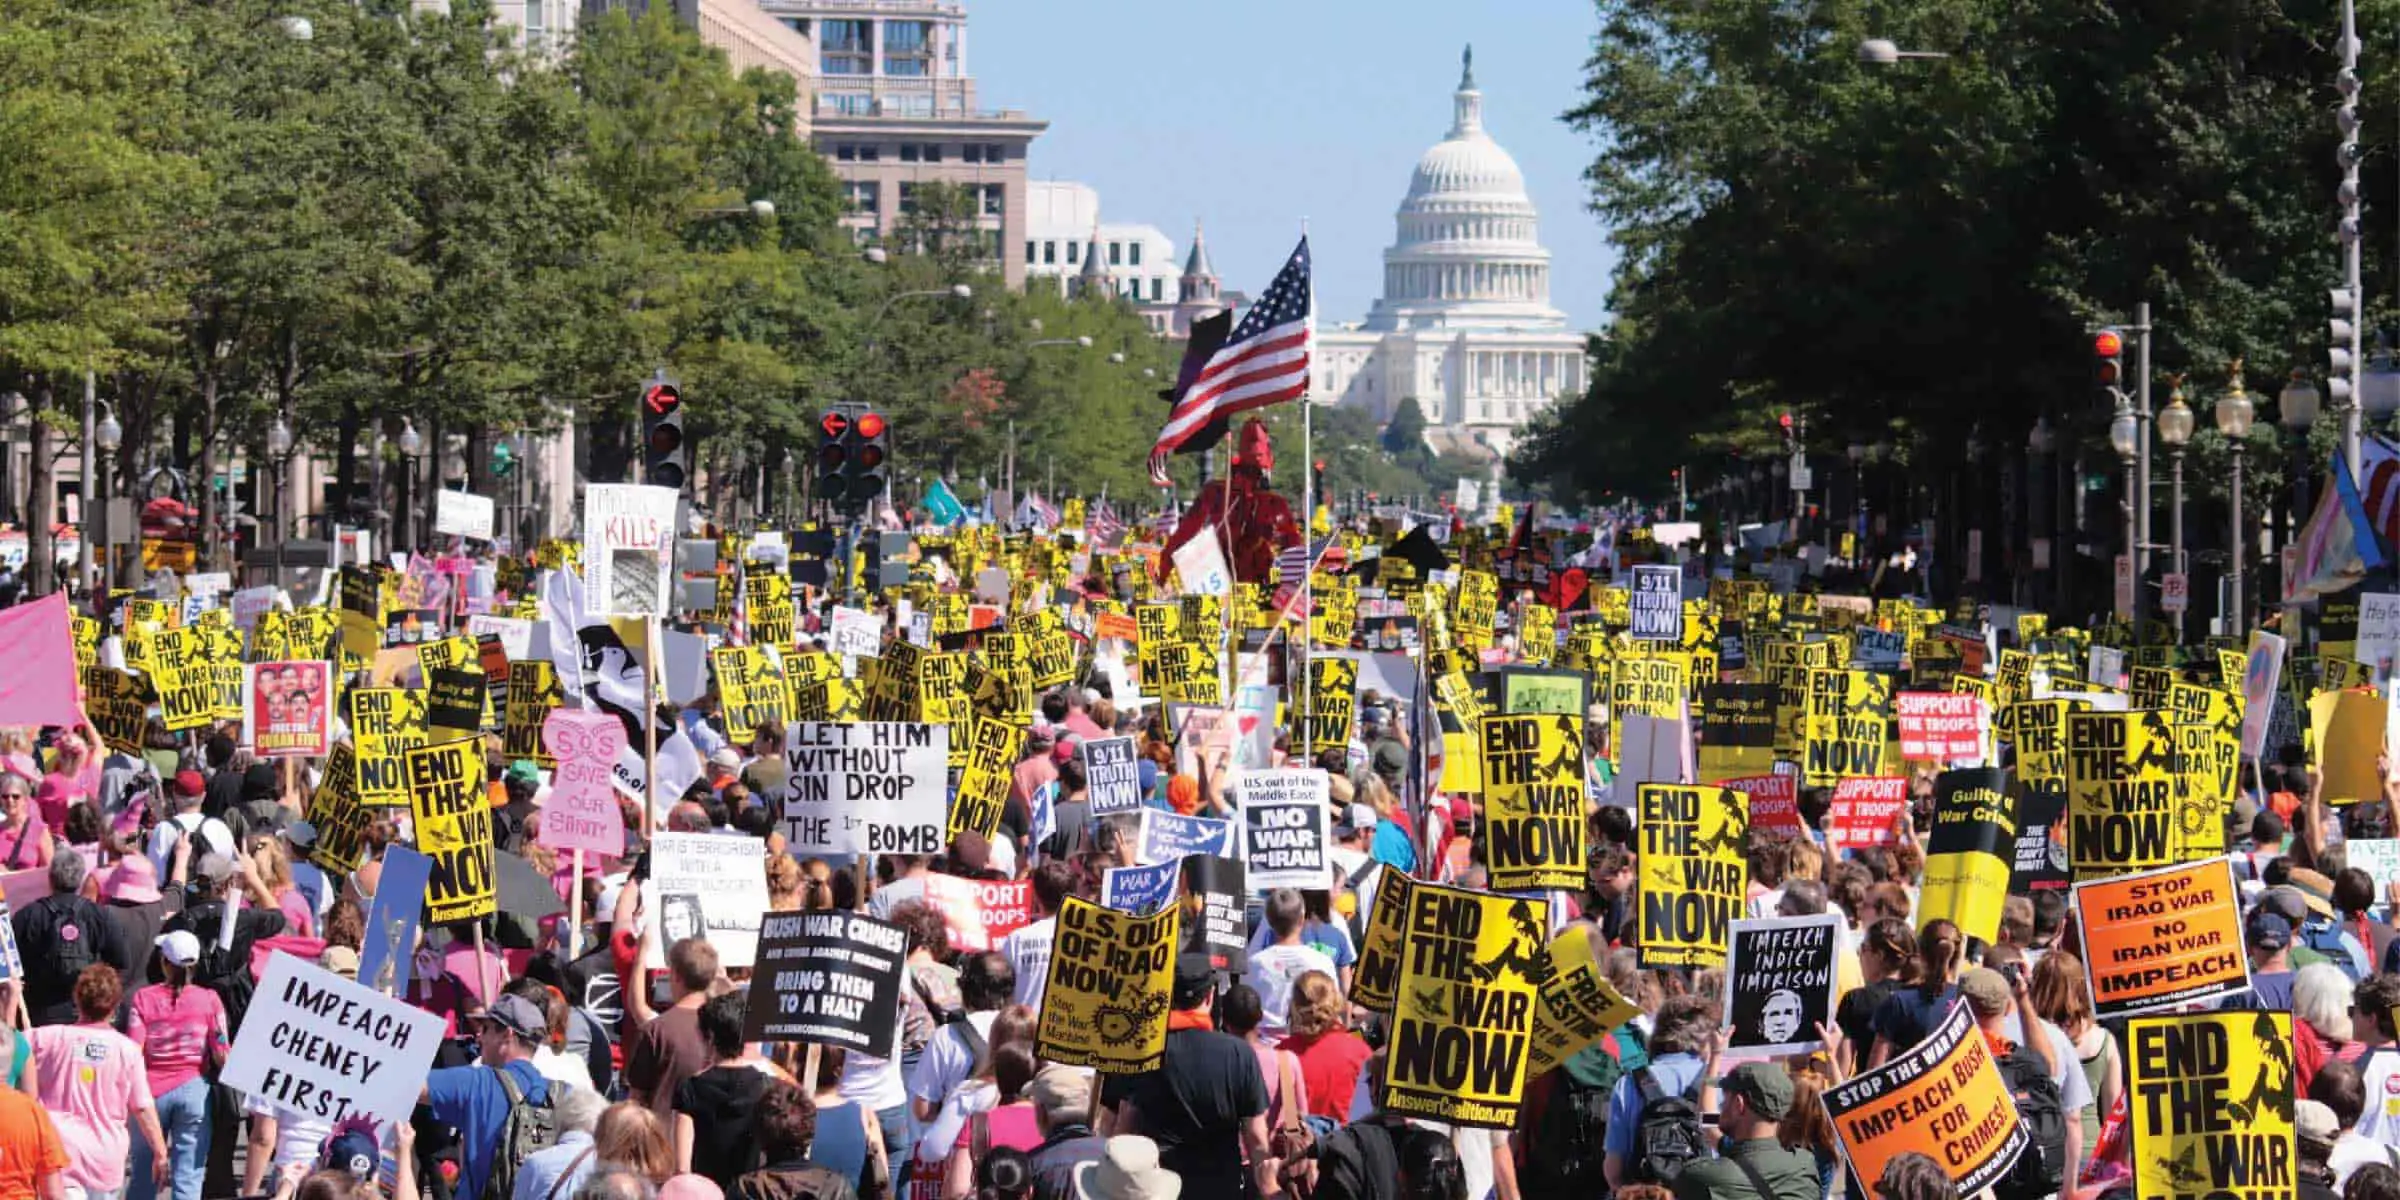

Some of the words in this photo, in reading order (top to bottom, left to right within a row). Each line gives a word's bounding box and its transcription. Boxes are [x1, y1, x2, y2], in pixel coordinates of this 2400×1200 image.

[606, 515, 657, 547] KILLS
[748, 580, 770, 592] END
[1640, 575, 1671, 591] 9/11
[1634, 591, 1679, 609] TRUTH
[765, 607, 790, 619] WAR
[1634, 609, 1676, 633] NOW
[288, 618, 313, 632] END
[751, 621, 791, 643] NOW
[1140, 626, 1166, 640] THE
[154, 633, 182, 651] END
[988, 637, 1015, 652] END
[1567, 637, 1591, 651] END
[923, 656, 952, 678] END
[989, 655, 1015, 670] THE
[1030, 651, 1071, 678] NOW
[1160, 648, 1189, 665] END
[1768, 647, 1798, 665] U.S.
[1803, 647, 1826, 666] OUT
[2002, 654, 2029, 668] END
[210, 666, 242, 681] WAR
[512, 664, 538, 679] END
[722, 670, 750, 685] THE
[1162, 668, 1190, 683] THE
[1650, 663, 1677, 683] OUT
[1768, 667, 1789, 687] OF
[925, 681, 954, 698] THE
[1615, 684, 1636, 701] OF
[1639, 683, 1673, 705] IRAQ
[1813, 672, 1849, 694] END
[356, 692, 391, 713] END
[1715, 698, 1748, 710] Guilty
[1751, 698, 1765, 710] of
[1814, 695, 1848, 716] THE
[1900, 696, 1975, 715] SUPPORT
[358, 714, 393, 736] THE
[1706, 712, 1729, 724] War
[1731, 712, 1772, 725] Crimes
[1902, 716, 1922, 731] THE
[1926, 716, 1976, 731] TROOPS
[2018, 704, 2058, 729] END
[799, 724, 851, 746] LET
[872, 724, 930, 747] HIM
[1487, 719, 1541, 748] END
[1837, 718, 1881, 742] WAR
[2071, 717, 2127, 748] END
[2187, 729, 2211, 750] OUT
[412, 747, 465, 784] END
[788, 749, 907, 774] WITHOUT
[1094, 748, 1126, 764] 9/11
[1807, 742, 1881, 774] NOW
[2075, 752, 2126, 781] THE
[565, 763, 611, 785] SAVE
[1090, 764, 1134, 781] TRUTH
[1488, 751, 1541, 785] THE
[789, 775, 828, 801] SIN
[846, 774, 915, 800] DROP
[1266, 778, 1285, 788] out
[1288, 777, 1299, 787] of
[1302, 777, 1319, 787] the
[1837, 778, 1906, 799] SUPPORT
[415, 781, 470, 819] THE
[569, 795, 604, 813] OUR
[1093, 782, 1138, 808] NOW
[1248, 791, 1286, 800] Middle
[1527, 784, 1579, 817] WAR
[1644, 788, 1700, 822] END
[1952, 787, 2002, 806] Guilty
[2109, 782, 2170, 813] WAR
[1260, 807, 1308, 828] NO
[1750, 800, 1794, 815] ROOPS
[1938, 809, 1968, 823] War
[787, 816, 832, 845] THE
[868, 824, 939, 852] BOMB
[1156, 817, 1186, 832] WAR
[2026, 825, 2046, 837] THE
[655, 839, 674, 853] WAR
[678, 840, 686, 854] IS
[1255, 830, 1315, 849] WAR
[1491, 817, 1580, 866] NOW
[1643, 823, 1699, 857] THE
[2074, 813, 2170, 862] NOW
[1252, 854, 1267, 863] on
[1268, 850, 1320, 867] IRAN
[2015, 849, 2046, 859] CAN'T
[714, 863, 721, 872] A
[1683, 858, 1741, 891] WAR
[1120, 872, 1152, 890] WAR
[2129, 876, 2192, 900] STOP
[2107, 901, 2164, 921] IRAQ
[2170, 889, 2215, 911] WAR
[1065, 904, 1120, 941] U.S.
[1125, 909, 1177, 948] OUT
[1414, 893, 1482, 941] END
[1644, 891, 1742, 942] NOW
[763, 917, 801, 938] BUSH
[805, 915, 844, 938] WAR
[848, 919, 904, 953] CRIMES
[1749, 927, 1825, 949] IMPEACH
[2153, 921, 2186, 938] NO
[1062, 931, 1100, 962] OF
[1104, 943, 1169, 975] IRAQ
[2112, 942, 2172, 962] IRAN
[2177, 930, 2221, 951] WAR
[1411, 933, 1475, 982] THE
[1755, 949, 1817, 969] INDICT
[1055, 958, 1124, 1002] NOW
[1738, 969, 1829, 991] IMPRISON
[2101, 952, 2237, 993] IMPEACH
[775, 971, 825, 990] BRING
[830, 972, 874, 1002] THEM
[1564, 964, 1614, 1017] FREE
[283, 976, 412, 1050] IMPEACH
[779, 993, 798, 1013] TO
[803, 995, 815, 1013] A
[821, 995, 864, 1022] HALT
[1051, 995, 1074, 1011] Stop
[1453, 983, 1530, 1032] WAR
[1048, 1011, 1065, 1022] the
[1068, 1016, 1089, 1030] War
[1046, 1025, 1090, 1042] Machine
[270, 1022, 382, 1085] CHENEY
[1038, 1043, 1161, 1074] AnswerCoalition.org
[1393, 1019, 1523, 1095] NOW
[2136, 1022, 2228, 1080] END
[1837, 1078, 1883, 1107] STOP
[1886, 1059, 1923, 1086] THE
[1921, 1039, 1951, 1065] WAR
[262, 1068, 352, 1123] FIRST
[1848, 1075, 1955, 1144] IMPEACH
[1952, 1040, 1986, 1089] BUSH
[1387, 1088, 1518, 1126] AnswerCoalition.org
[2138, 1078, 2231, 1137] THE
[1930, 1104, 1970, 1140] FOR
[1944, 1096, 2008, 1167] CRIMES!
[2203, 1134, 2289, 1188] WAR
